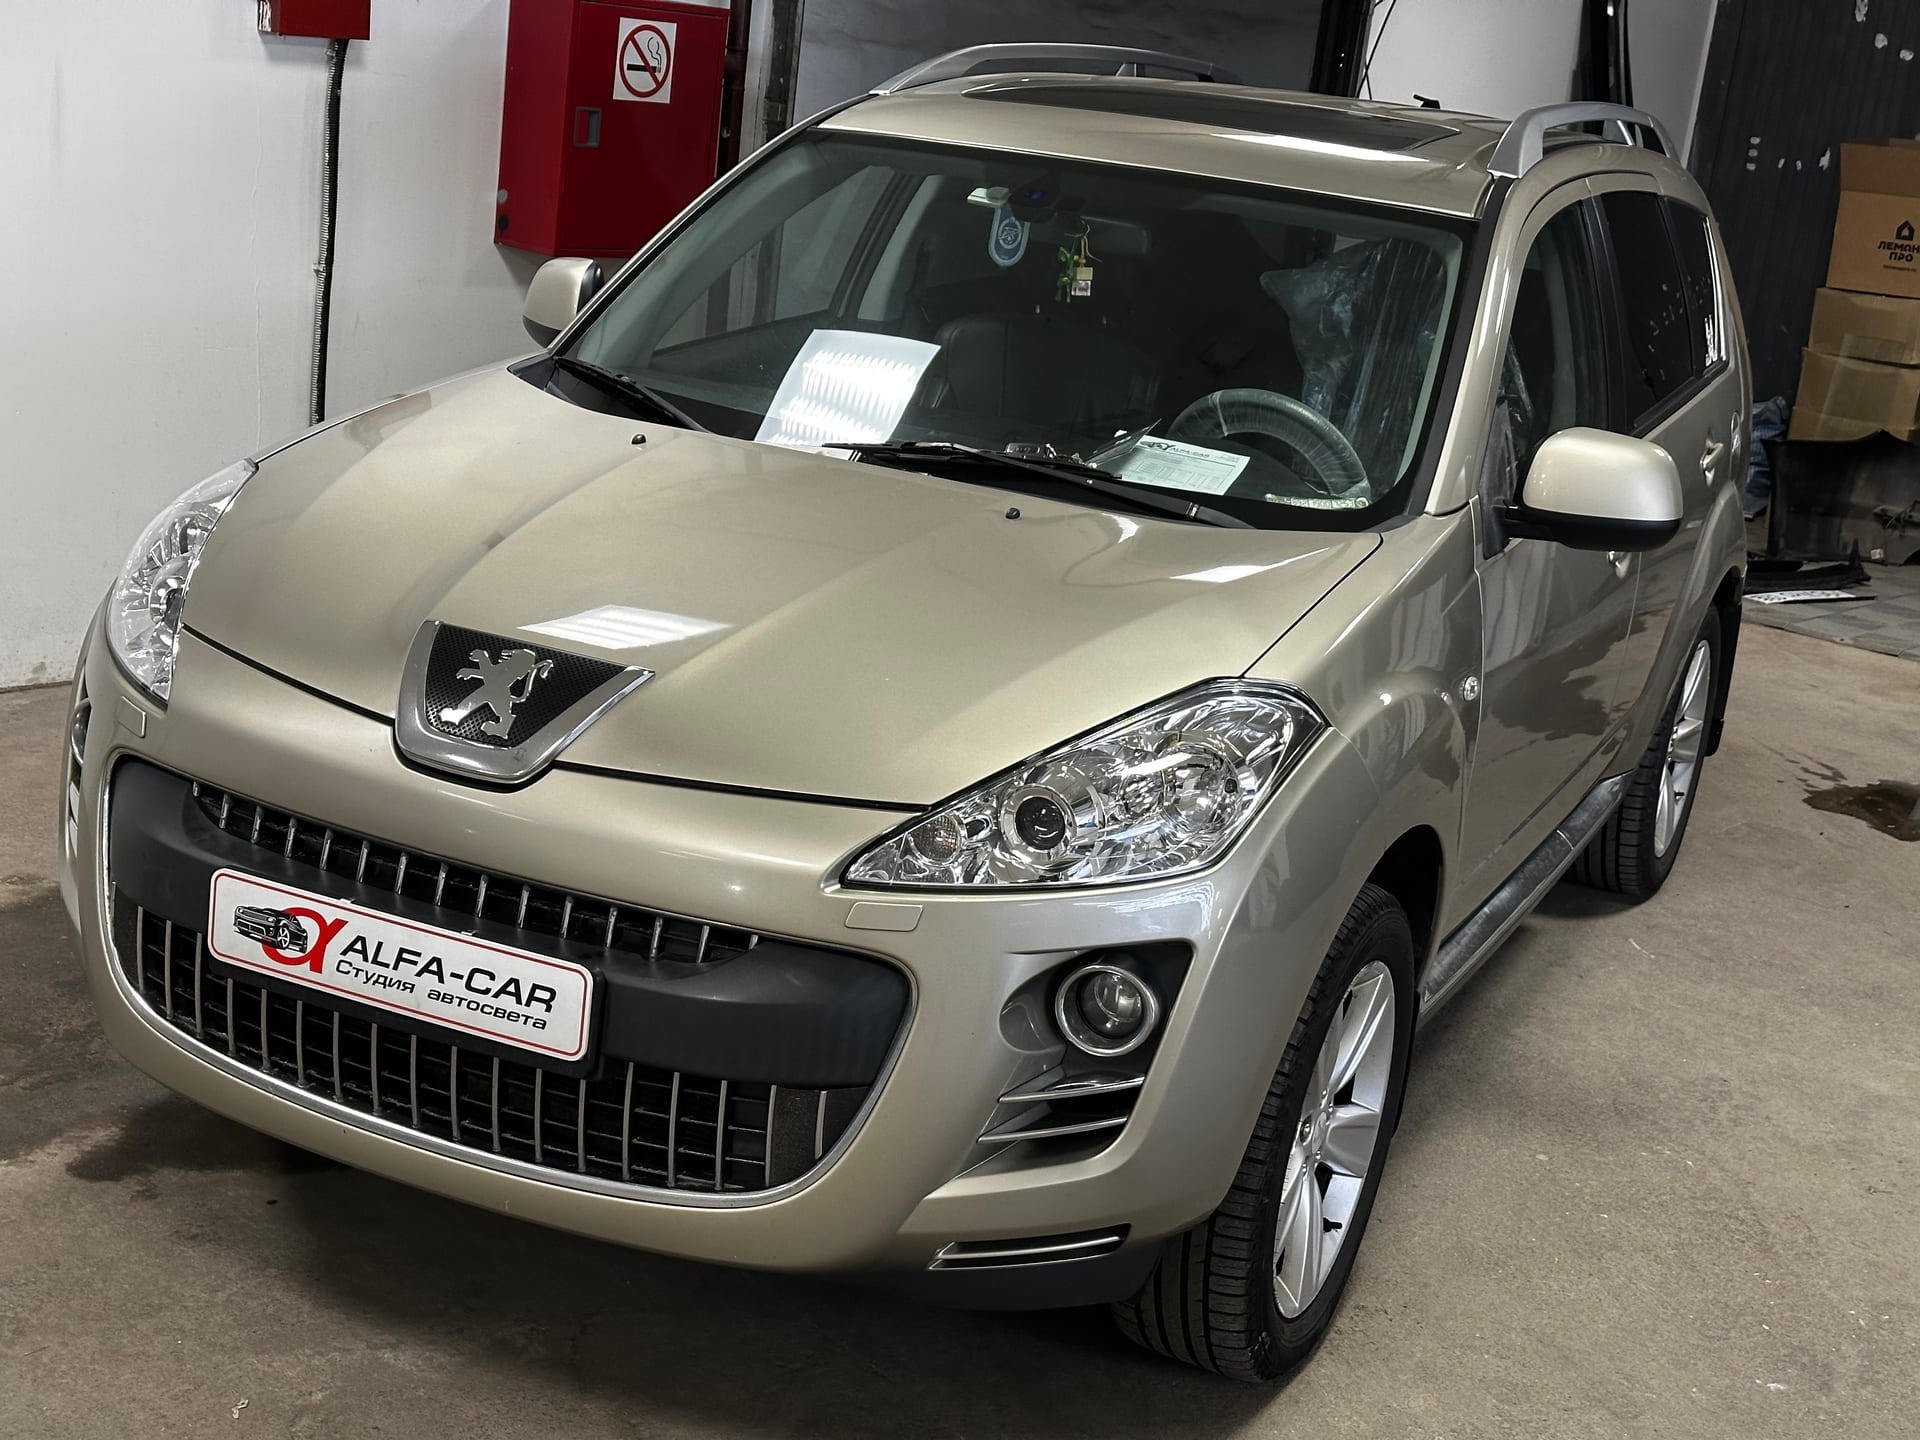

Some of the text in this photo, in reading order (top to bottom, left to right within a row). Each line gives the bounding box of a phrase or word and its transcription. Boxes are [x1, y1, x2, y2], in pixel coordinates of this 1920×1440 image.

[1889, 252, 1914, 262] ПРО
[335, 959, 548, 1031] Студия автосвета
[340, 935, 557, 1013] ALFA-CAR
